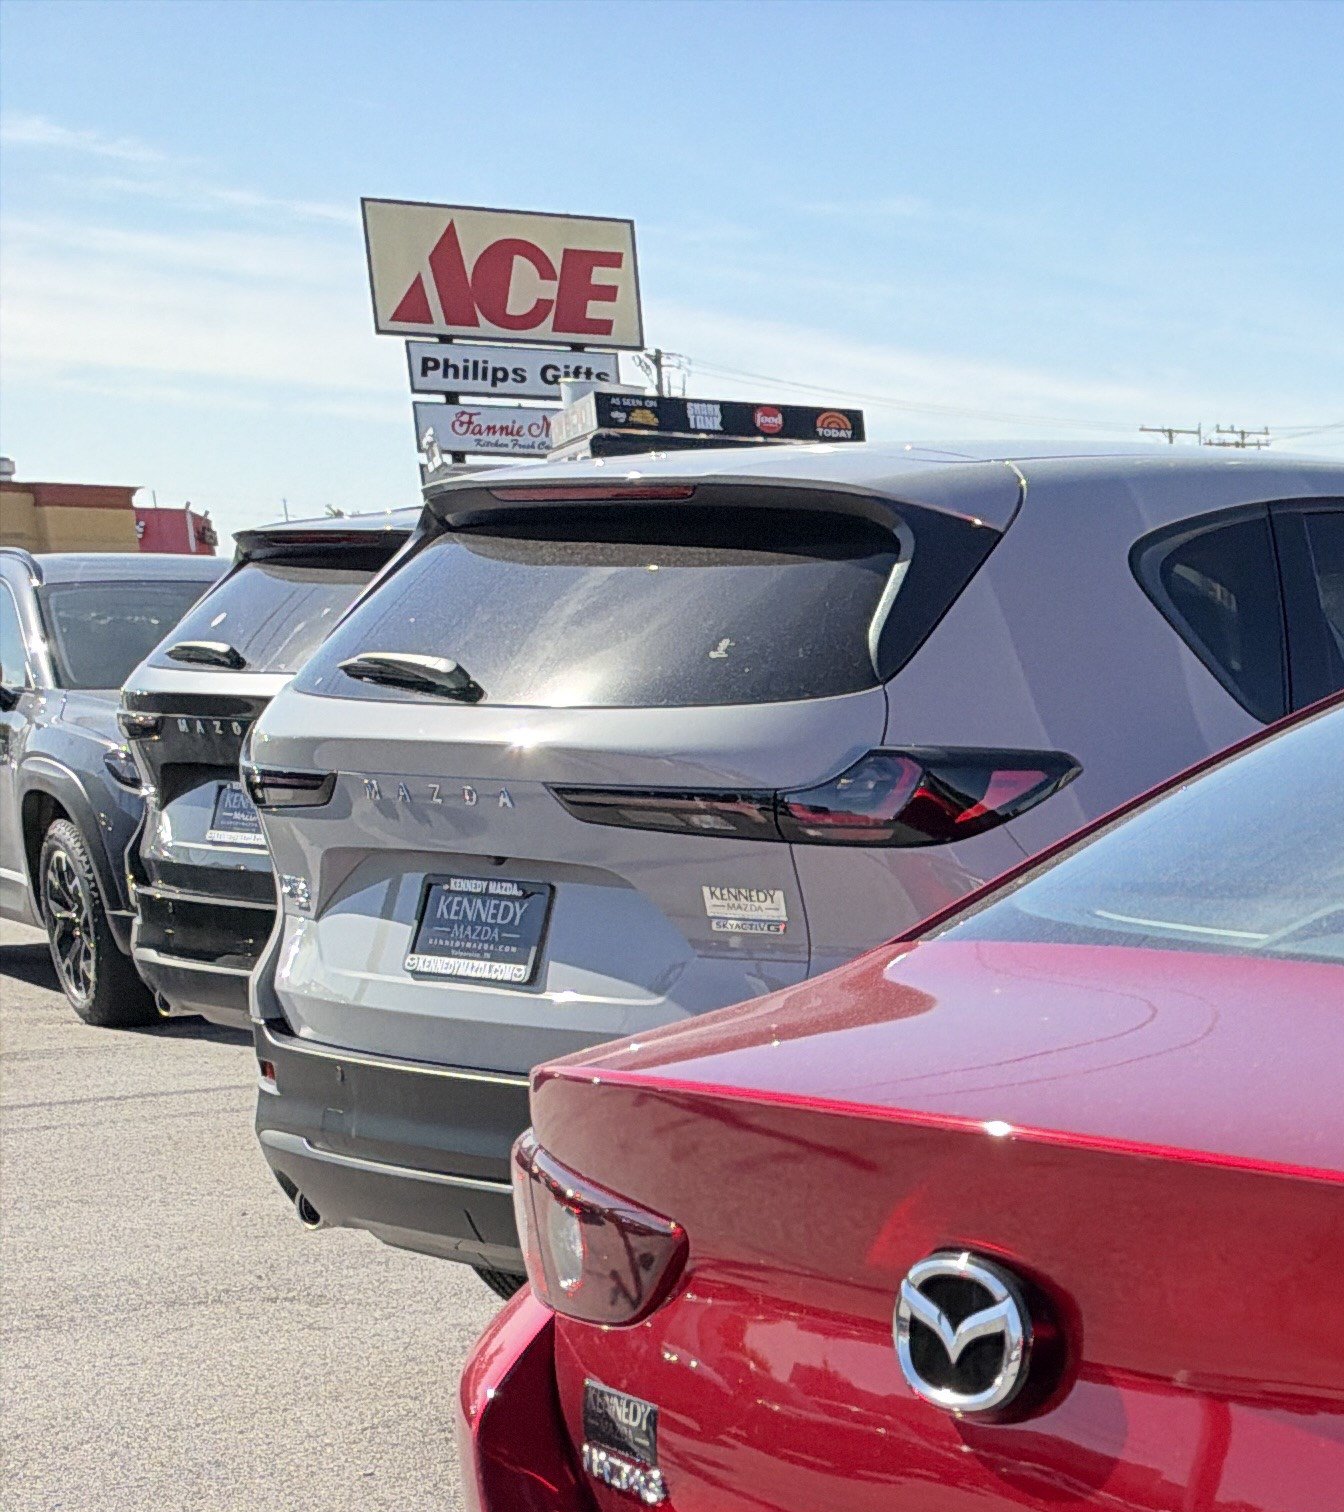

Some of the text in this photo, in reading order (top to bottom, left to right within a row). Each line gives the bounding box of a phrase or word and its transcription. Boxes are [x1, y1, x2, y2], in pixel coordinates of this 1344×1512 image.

[389, 218, 624, 336] ACE
[420, 356, 528, 388] Philips
[451, 410, 526, 438] Fannie
[755, 409, 783, 427] food
[816, 426, 852, 439] TODAY
[177, 718, 242, 736] MAZD
[363, 778, 514, 809] MAZDA
[450, 877, 518, 896] KENNEDY MAZDA
[709, 886, 776, 904] KENNEDY
[436, 895, 529, 927] KENNEDY
[726, 902, 764, 913] MAZDA
[449, 922, 500, 942] MAZDA
[417, 955, 514, 982] KENNEDYMAZDA.COM
[587, 1386, 652, 1432] KENNEDY
